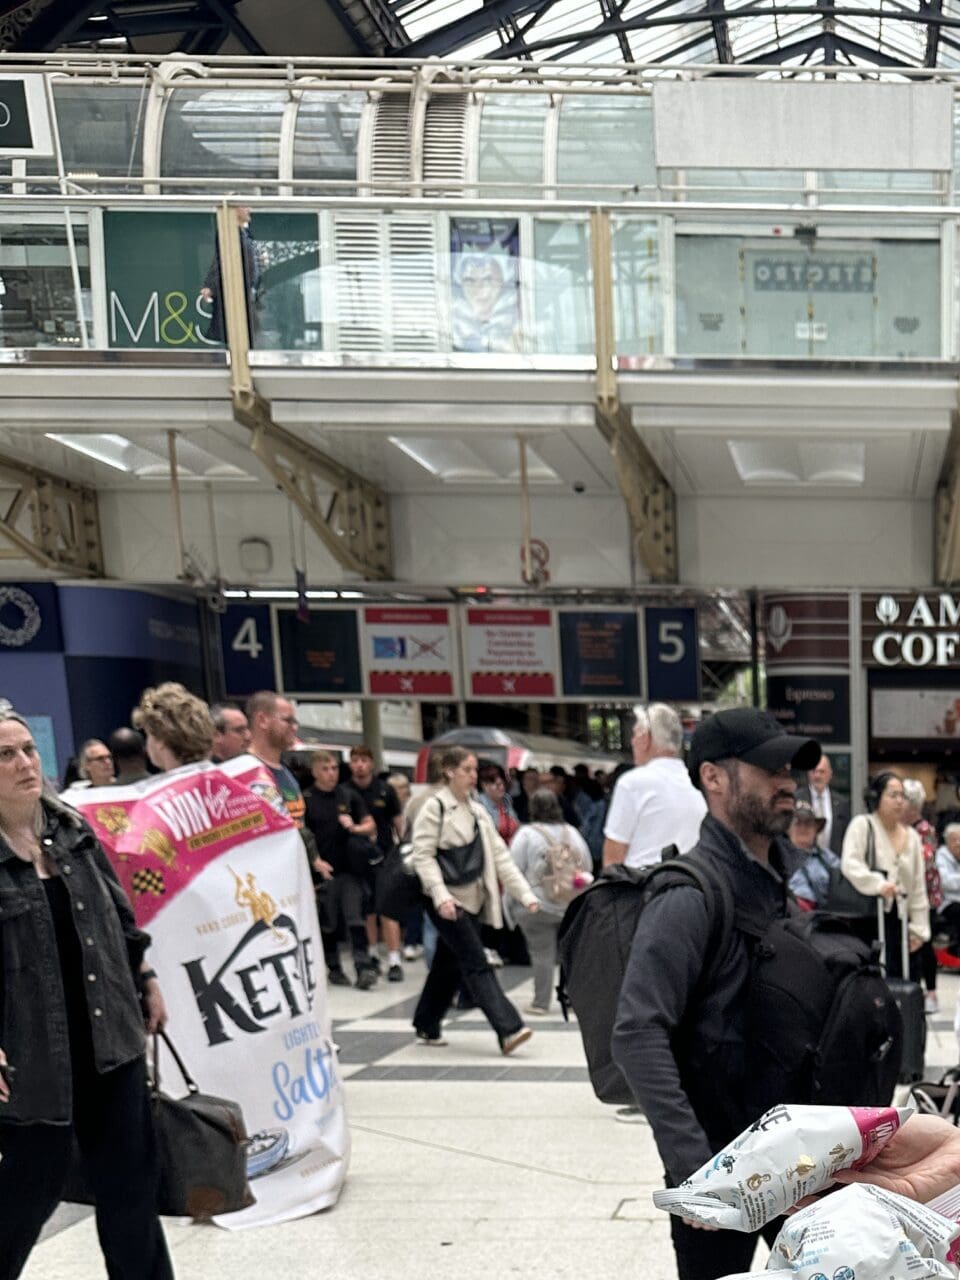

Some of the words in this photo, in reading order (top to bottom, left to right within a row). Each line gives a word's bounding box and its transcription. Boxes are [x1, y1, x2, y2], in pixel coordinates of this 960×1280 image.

[231, 617, 263, 659] 4
[658, 621, 685, 663] 5
[150, 787, 212, 842] WIN
[181, 914, 317, 1047] KETE
[282, 1021, 321, 1051] LIGHTL
[272, 1046, 333, 1121] Salt
